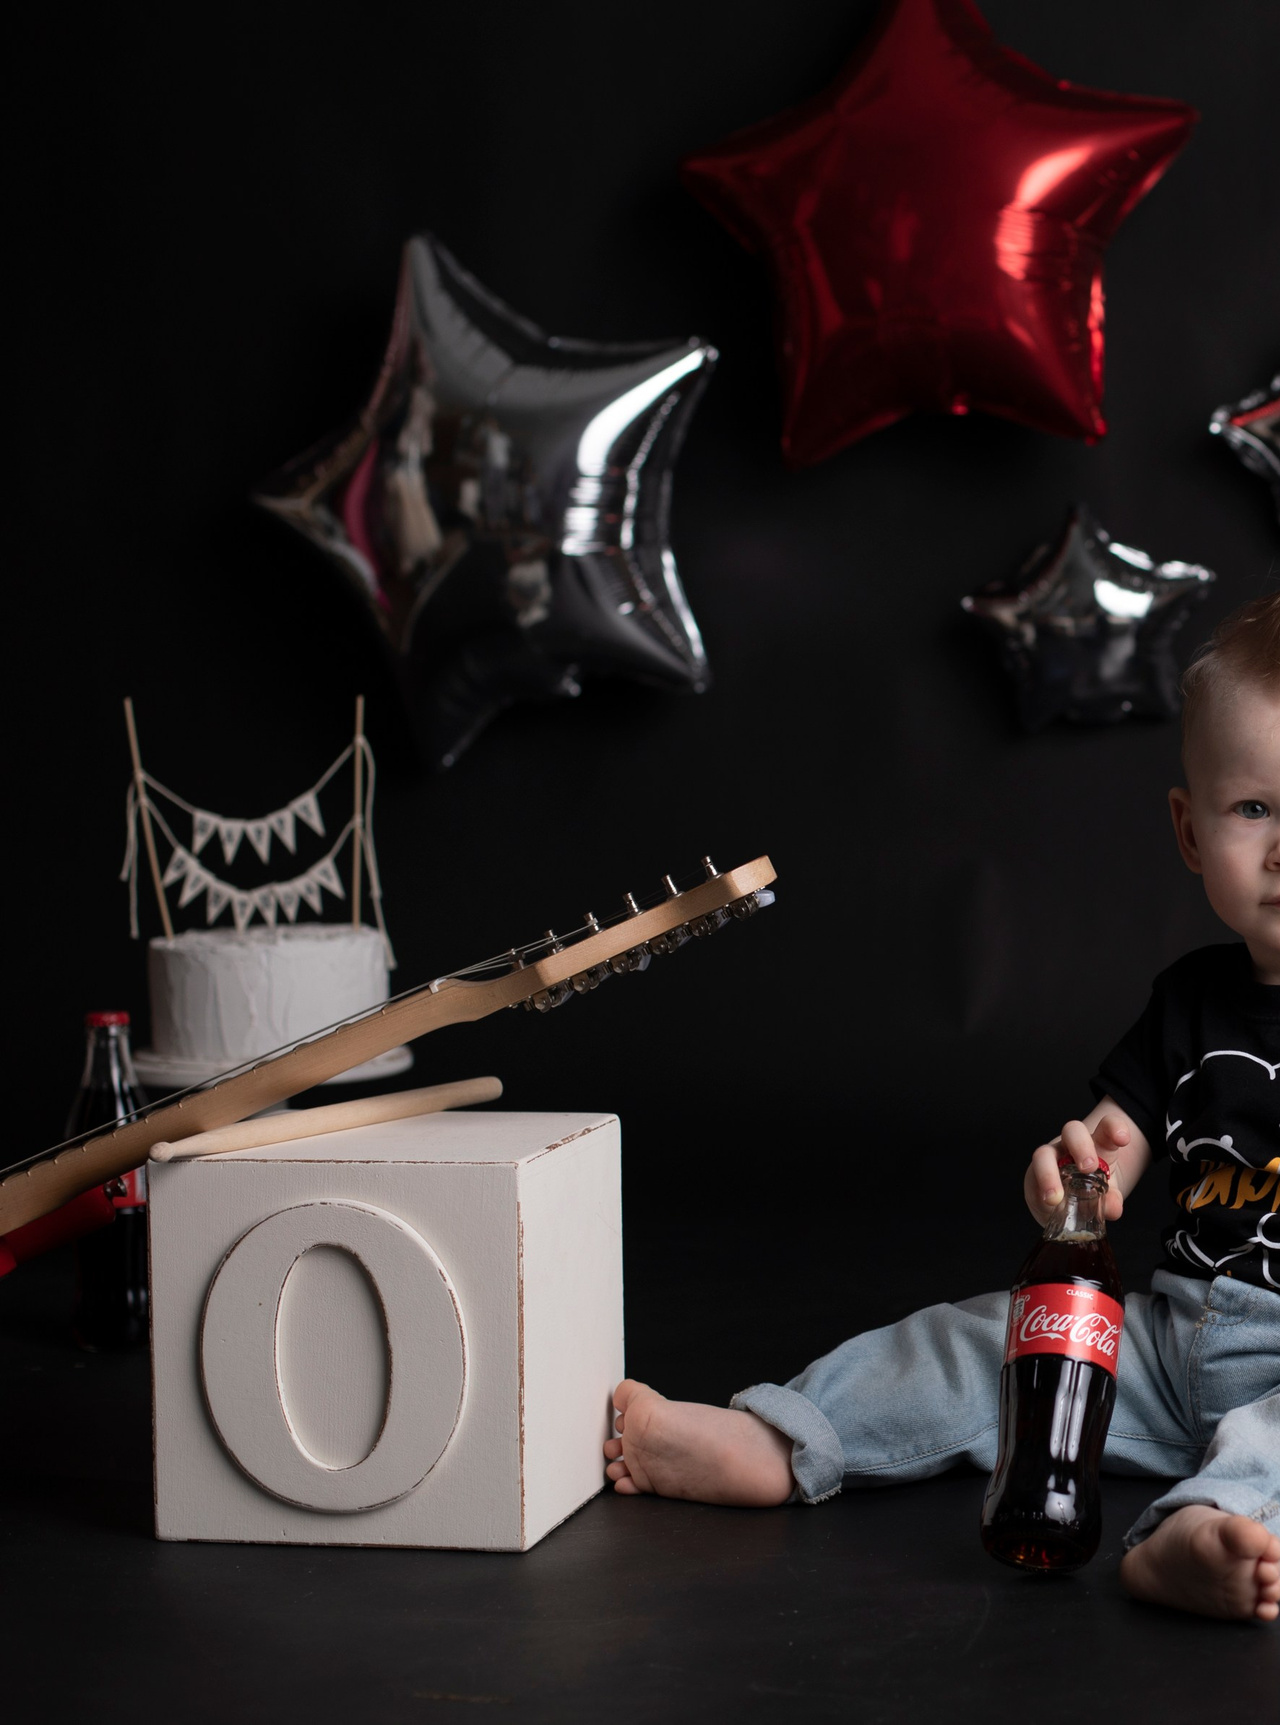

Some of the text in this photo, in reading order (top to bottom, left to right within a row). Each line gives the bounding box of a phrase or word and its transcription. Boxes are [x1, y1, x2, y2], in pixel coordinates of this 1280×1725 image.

[1066, 1288, 1094, 1301] CLASSIC
[201, 1198, 470, 1513] O
[1019, 1305, 1121, 1357] Coca-Cola
